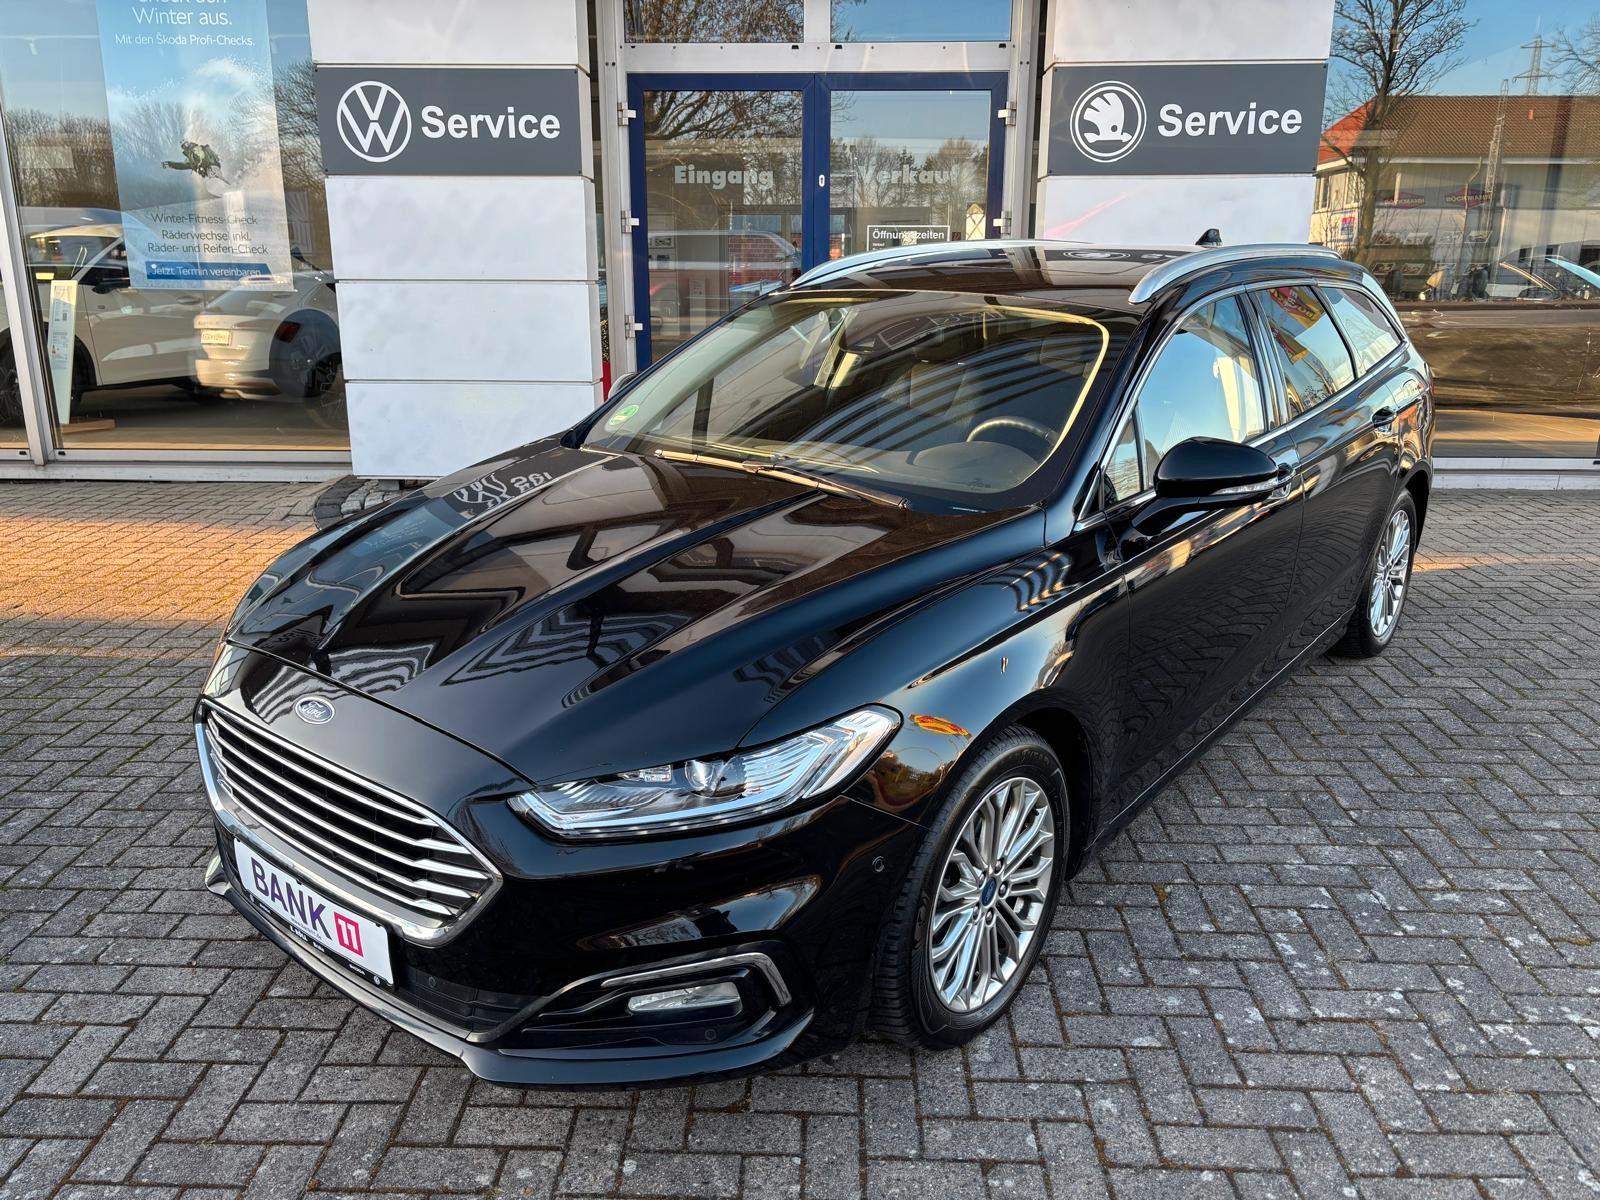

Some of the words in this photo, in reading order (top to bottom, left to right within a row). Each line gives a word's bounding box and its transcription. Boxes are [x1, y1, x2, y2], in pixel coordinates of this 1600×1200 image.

[132, 7, 194, 25] Winter
[199, 11, 233, 26] aus.
[115, 33, 132, 45] Mit
[134, 33, 154, 45] den
[156, 32, 187, 45] Škoda
[189, 34, 256, 46] Profi-Checks.
[421, 105, 561, 139] Service
[1157, 102, 1302, 137] Service
[674, 164, 774, 190] Eingang
[872, 228, 945, 239] Öffnunzeiten
[147, 242, 180, 254] Räder-
[183, 243, 201, 253] und
[203, 244, 269, 255] Reifen-Check
[152, 265, 175, 275] Jetzt
[177, 266, 208, 277] Termin
[251, 857, 332, 941] BANK
